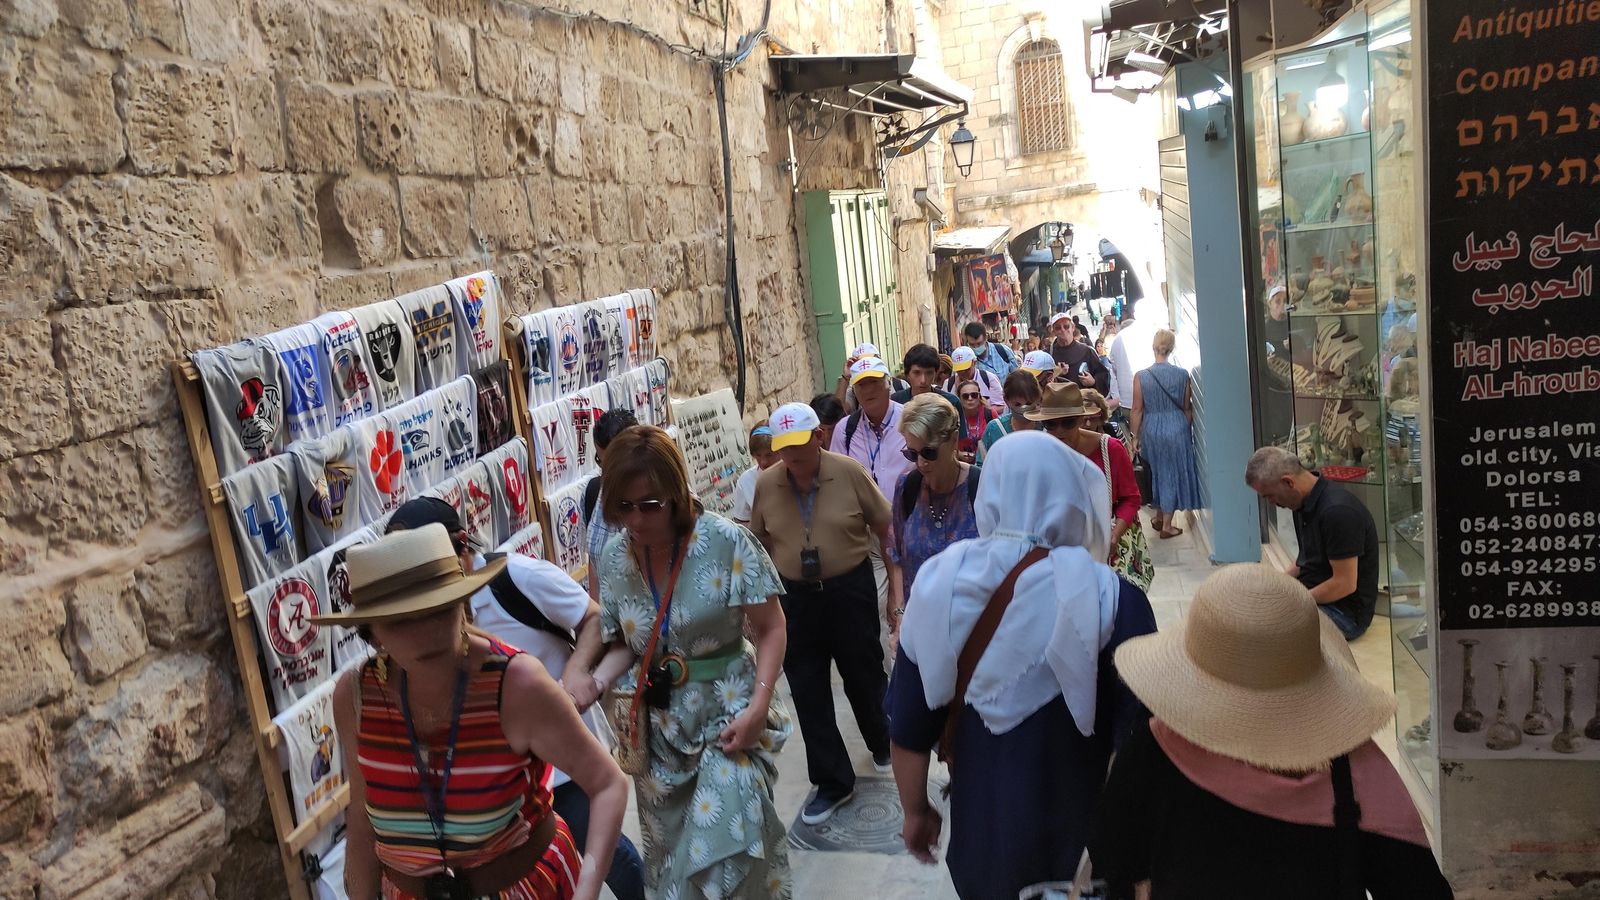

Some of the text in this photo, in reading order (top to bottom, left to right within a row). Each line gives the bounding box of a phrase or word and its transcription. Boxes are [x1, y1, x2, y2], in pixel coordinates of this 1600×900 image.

[1453, 230, 1520, 272] نبيل
[1472, 265, 1593, 315] الحروب
[1454, 338, 1501, 371] Haj
[1461, 365, 1600, 402] AL-hroub
[1469, 421, 1596, 443] Jerusalem
[1460, 449, 1497, 466] old
[1507, 446, 1558, 465] city,
[1486, 469, 1581, 487] Dolorsa
[1505, 491, 1560, 508] TEL:
[1459, 511, 1600, 533] 054-360068
[1460, 534, 1600, 555] 052-240847
[1461, 557, 1600, 577] 054-924295
[1507, 580, 1562, 597] FAX:
[1468, 601, 1600, 619] 02-6289938
